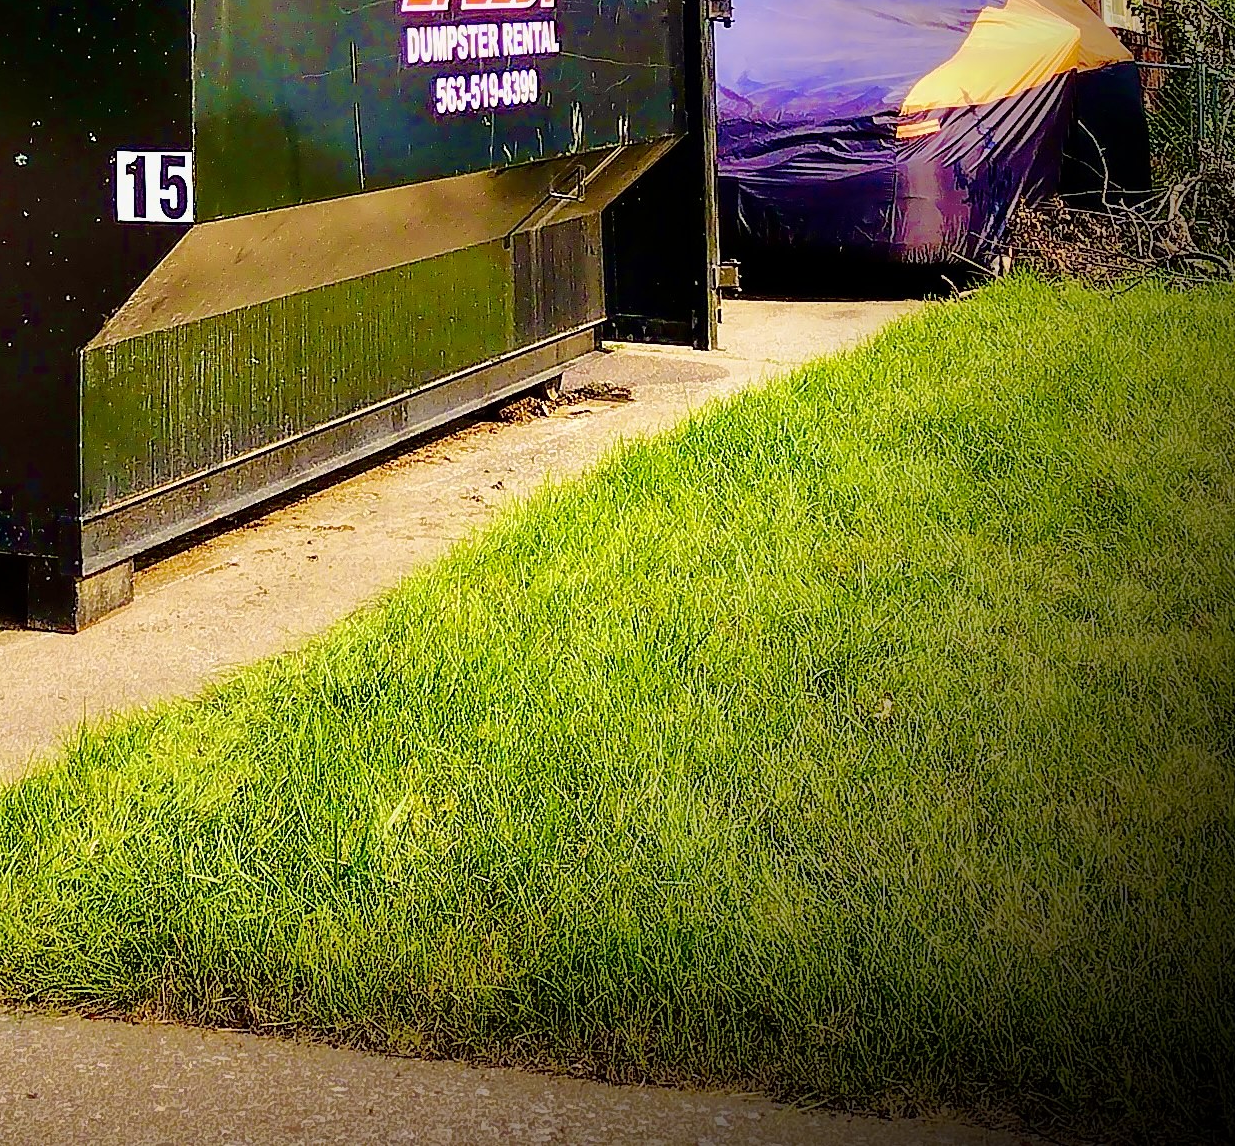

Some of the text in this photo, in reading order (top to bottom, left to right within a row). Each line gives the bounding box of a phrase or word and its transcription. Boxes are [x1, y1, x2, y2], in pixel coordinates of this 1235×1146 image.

[406, 20, 560, 64] DUMPSTER RENTAL
[436, 68, 539, 114] 563-519-8399
[126, 155, 188, 220] 15
